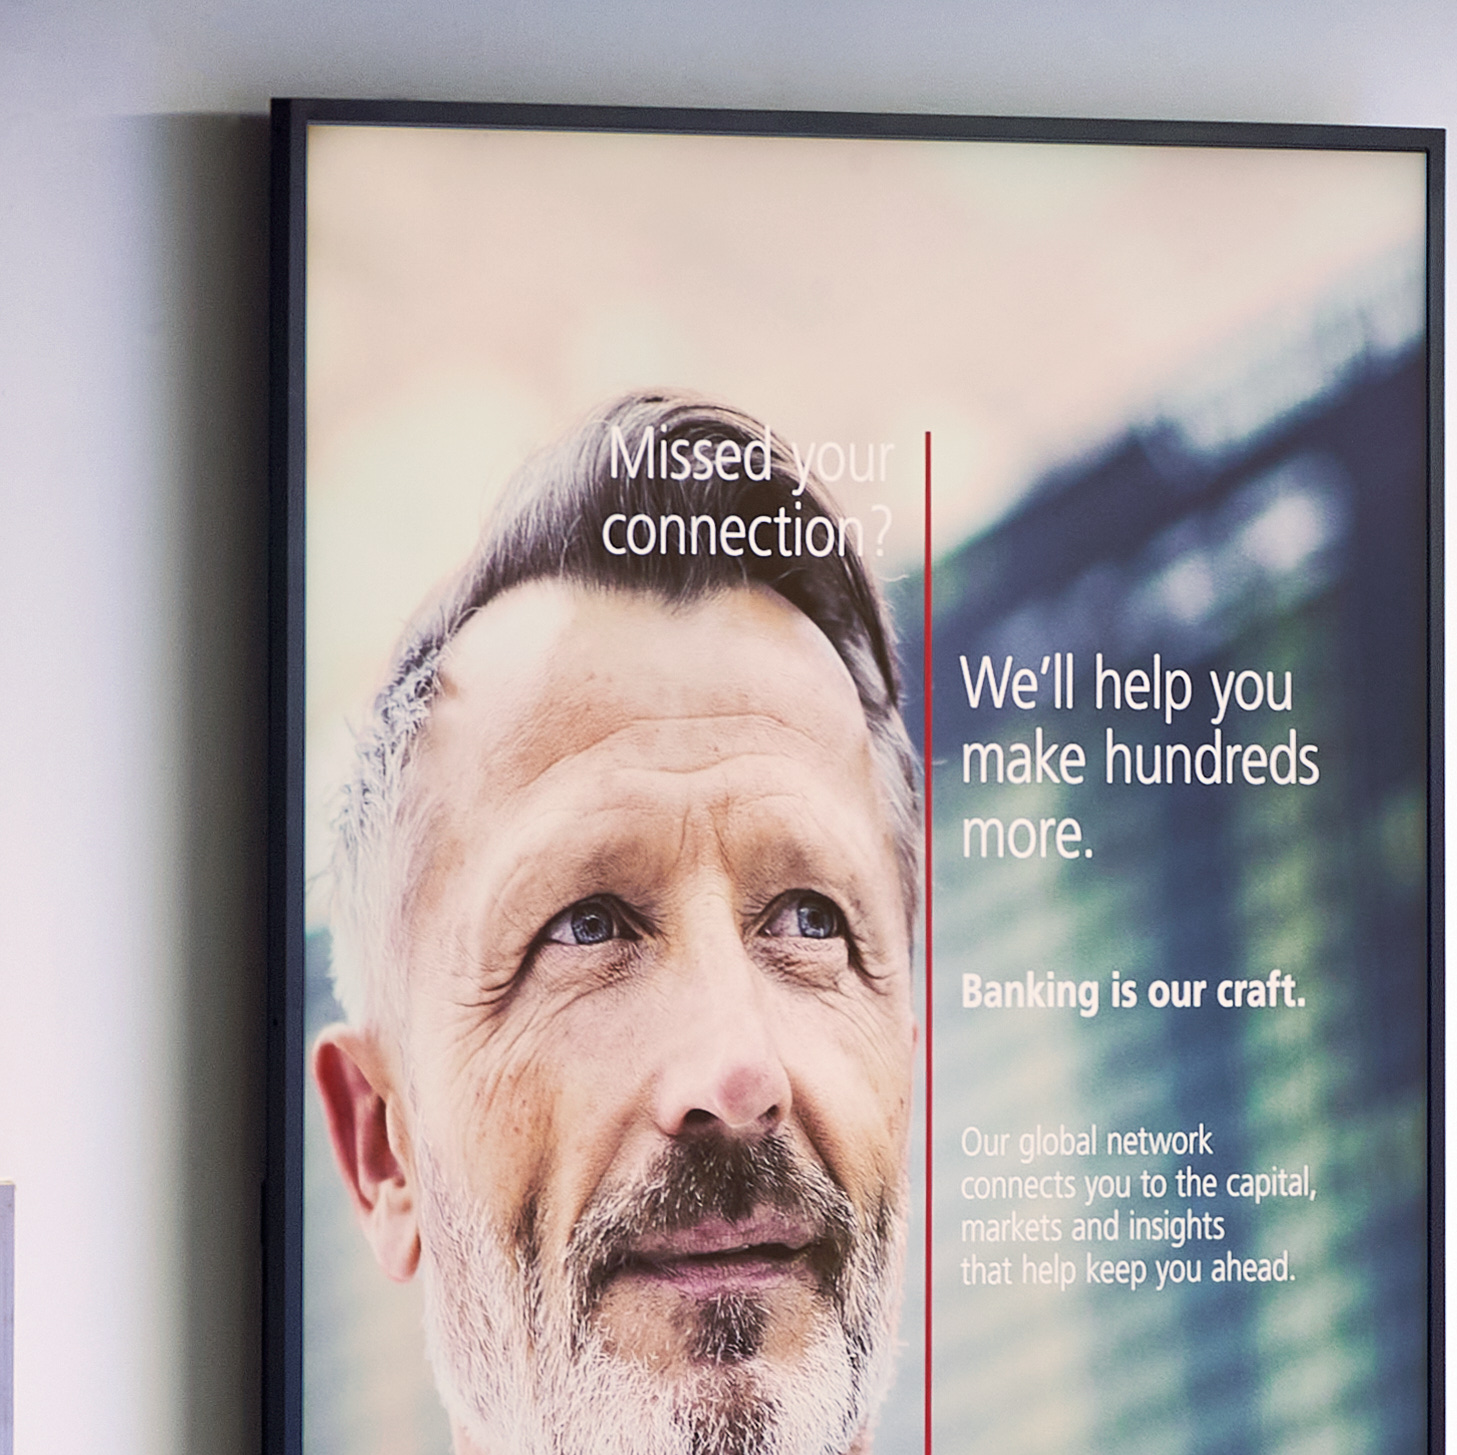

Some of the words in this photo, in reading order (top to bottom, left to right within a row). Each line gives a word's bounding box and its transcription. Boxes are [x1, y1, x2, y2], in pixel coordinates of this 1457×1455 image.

[609, 424, 772, 482] Missed
[791, 439, 896, 497] your
[601, 500, 893, 558] connection?
[959, 653, 1074, 711] We’ll
[1094, 653, 1193, 724] help
[1211, 667, 1293, 726] you
[962, 729, 1086, 785] make
[1105, 729, 1320, 786] hundreds
[962, 809, 1094, 858] more.
[961, 971, 1100, 1018] Banking
[1111, 971, 1138, 1008] is
[1148, 978, 1208, 1008] our
[1216, 969, 1307, 1008] craft.
[961, 1126, 1010, 1158] Our
[1019, 1124, 1097, 1163] global
[1106, 1123, 1214, 1157] network
[961, 1169, 1076, 1201] connects
[1084, 1173, 1131, 1205] you
[1140, 1169, 1167, 1198] to
[1175, 1166, 1218, 1198] the
[1225, 1165, 1317, 1203] capital,
[961, 1211, 1063, 1243] markets
[1071, 1210, 1120, 1242] and
[1129, 1209, 1226, 1248] insights
[961, 1255, 1012, 1286] that
[1022, 1254, 1077, 1291] help
[1086, 1252, 1148, 1291] keep
[1155, 1258, 1203, 1291] you
[1211, 1250, 1296, 1283] ahead.
